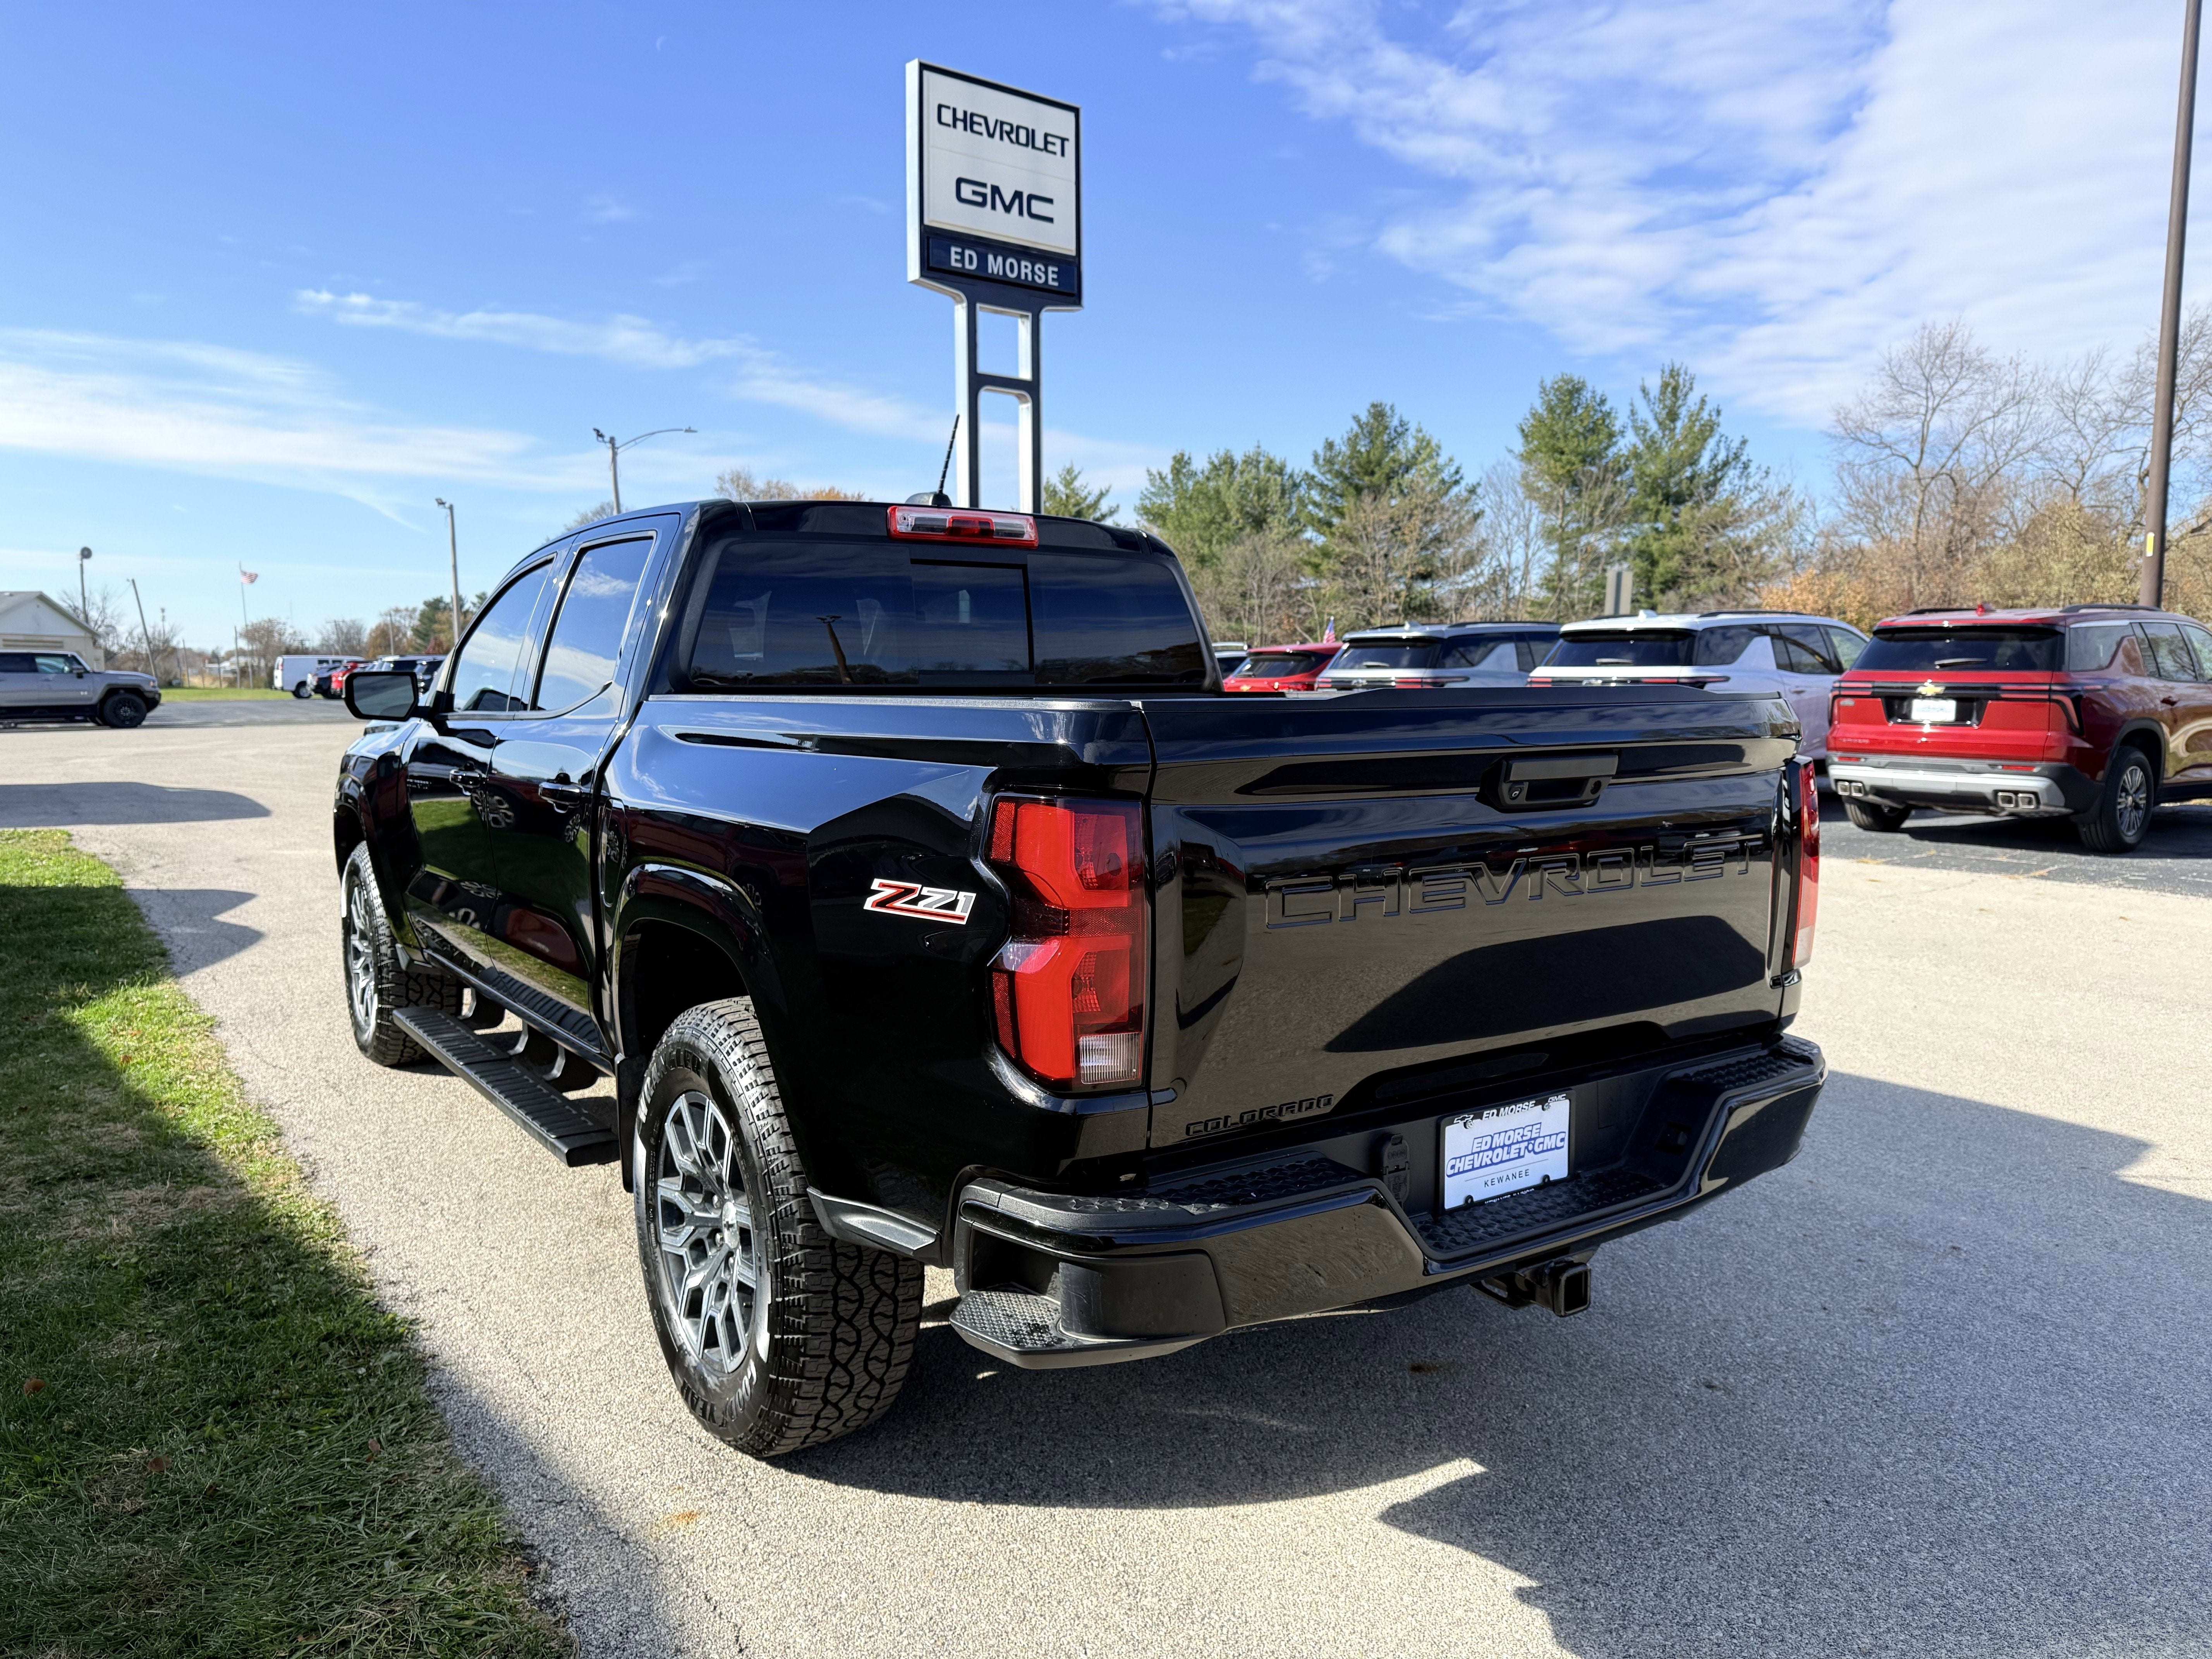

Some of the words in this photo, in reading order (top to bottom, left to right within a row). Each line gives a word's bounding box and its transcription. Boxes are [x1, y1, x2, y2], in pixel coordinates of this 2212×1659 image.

[937, 103, 1069, 157] CHEVROLET
[955, 177, 1054, 223] GMC
[950, 246, 977, 270] ED
[988, 252, 1059, 286] MORSE
[863, 878, 976, 925] Z71
[1266, 834, 1764, 928] CHEVROLET
[1185, 1094, 1334, 1136] COLORADO
[1482, 1109, 1497, 1121] ED
[1499, 1101, 1536, 1117] MORSE
[1548, 1094, 1566, 1103] GMC
[1472, 1134, 1492, 1153] ED
[1492, 1122, 1542, 1149] MORSE
[1484, 1169, 1530, 1187] KEWANEE
